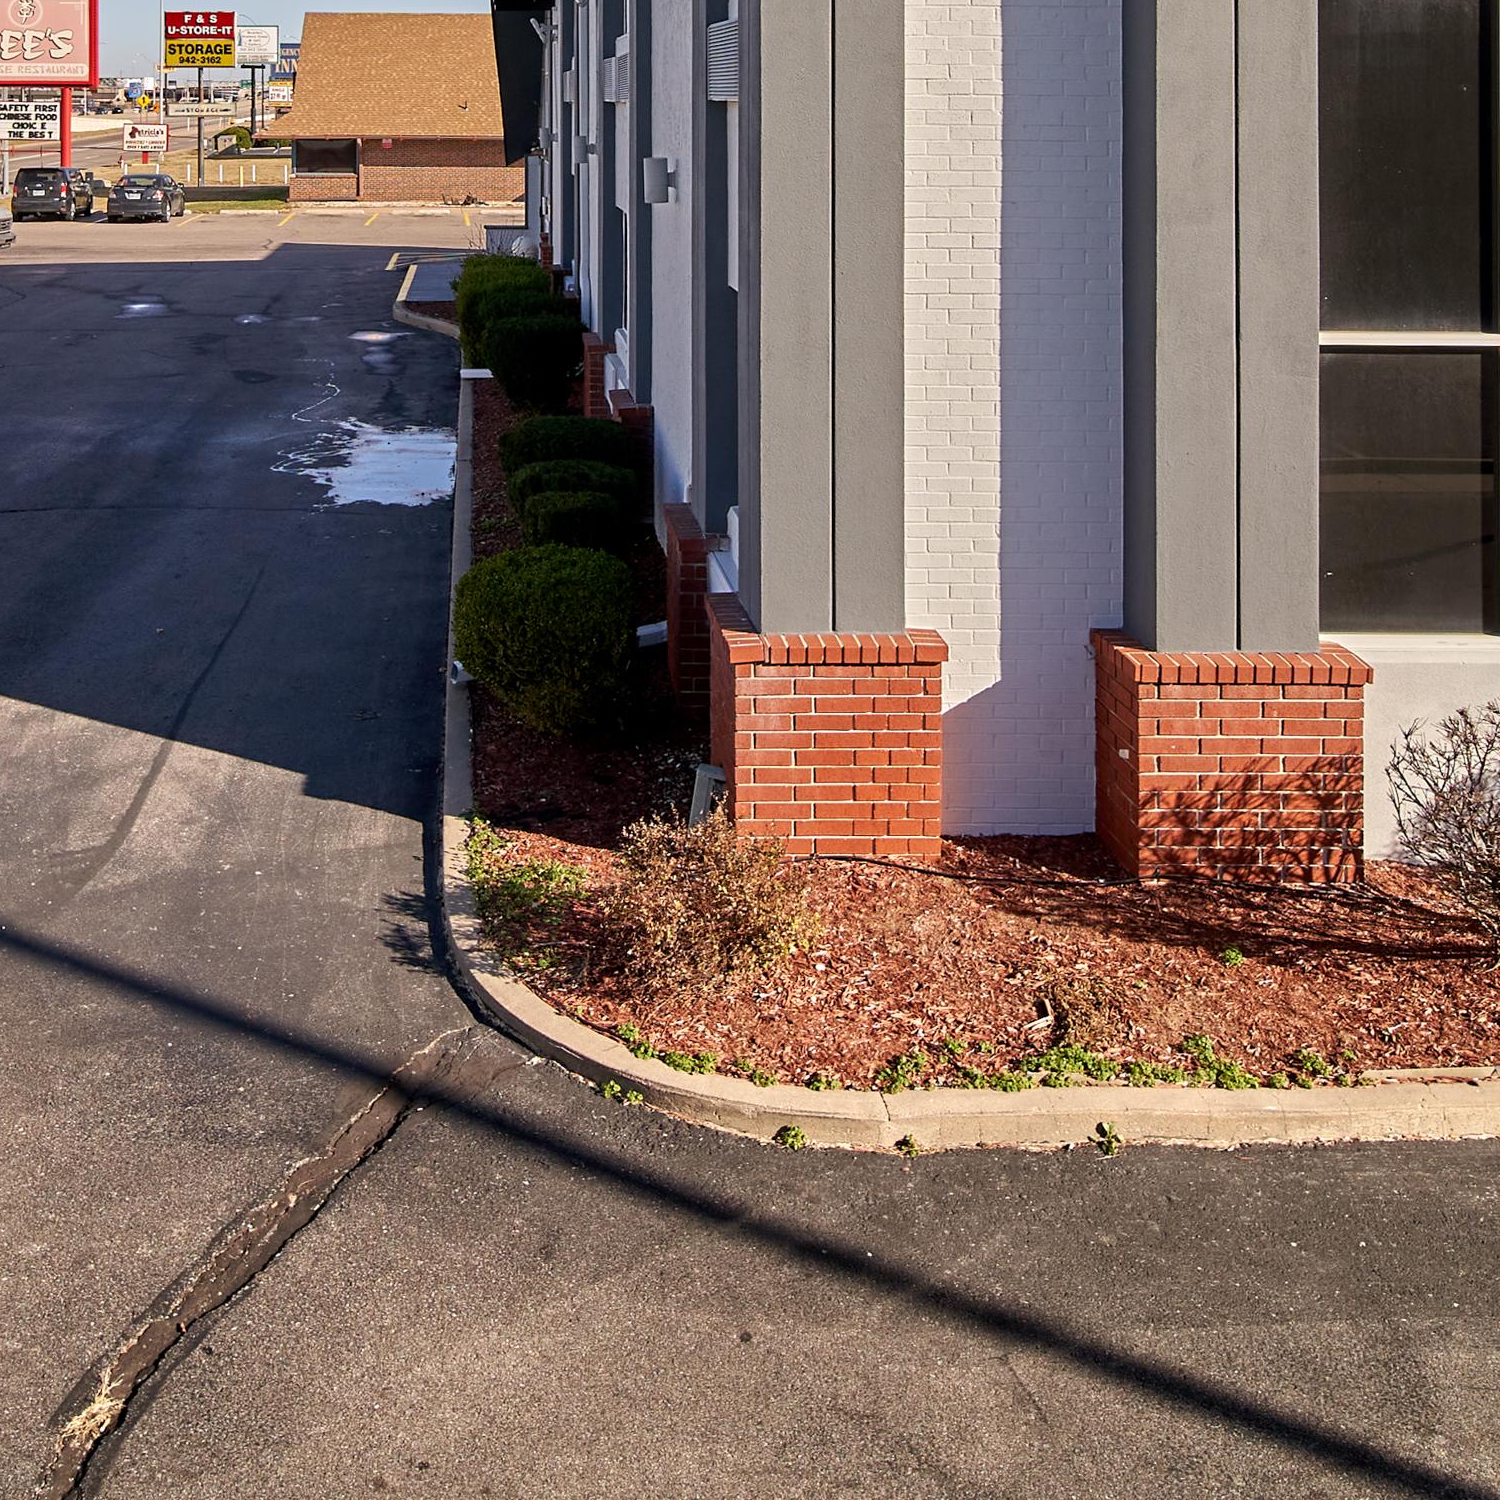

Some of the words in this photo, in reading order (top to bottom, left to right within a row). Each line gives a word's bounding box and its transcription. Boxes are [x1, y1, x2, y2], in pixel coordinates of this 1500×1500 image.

[184, 15, 192, 23] F
[196, 15, 204, 23] &
[210, 15, 217, 23] S
[168, 26, 232, 34] U-STORE-IT
[168, 44, 232, 54] STORAGE
[179, 56, 221, 64] 942-3162
[18, 66, 85, 75] RESTAURANT
